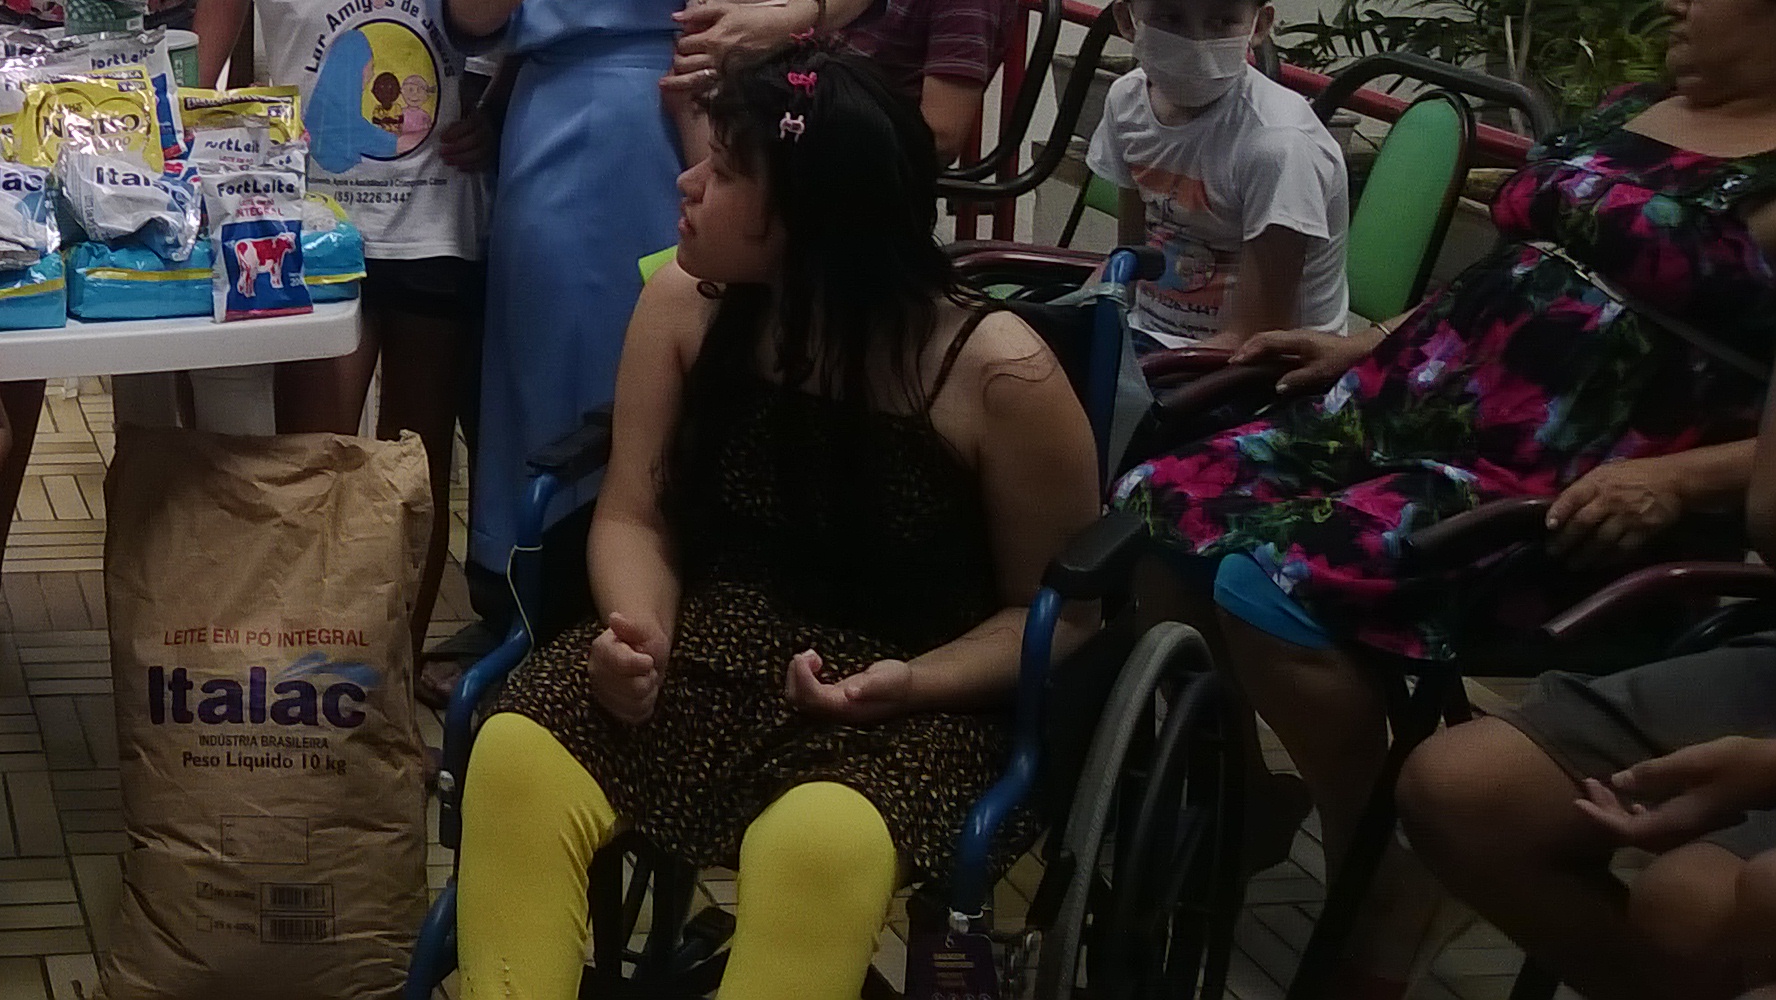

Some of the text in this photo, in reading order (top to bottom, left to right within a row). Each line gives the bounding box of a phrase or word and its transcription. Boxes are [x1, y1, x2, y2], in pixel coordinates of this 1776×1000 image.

[305, 34, 325, 73] Lar
[216, 179, 295, 198] FortLeite
[164, 627, 371, 647] LEITE EM PÓ INTEGRAL
[148, 665, 367, 728] Italac
[199, 733, 329, 749] INDÚSTRIA BRASILEIRA
[182, 751, 220, 768] Peso
[301, 754, 321, 770] 10
[326, 755, 347, 774] kg
